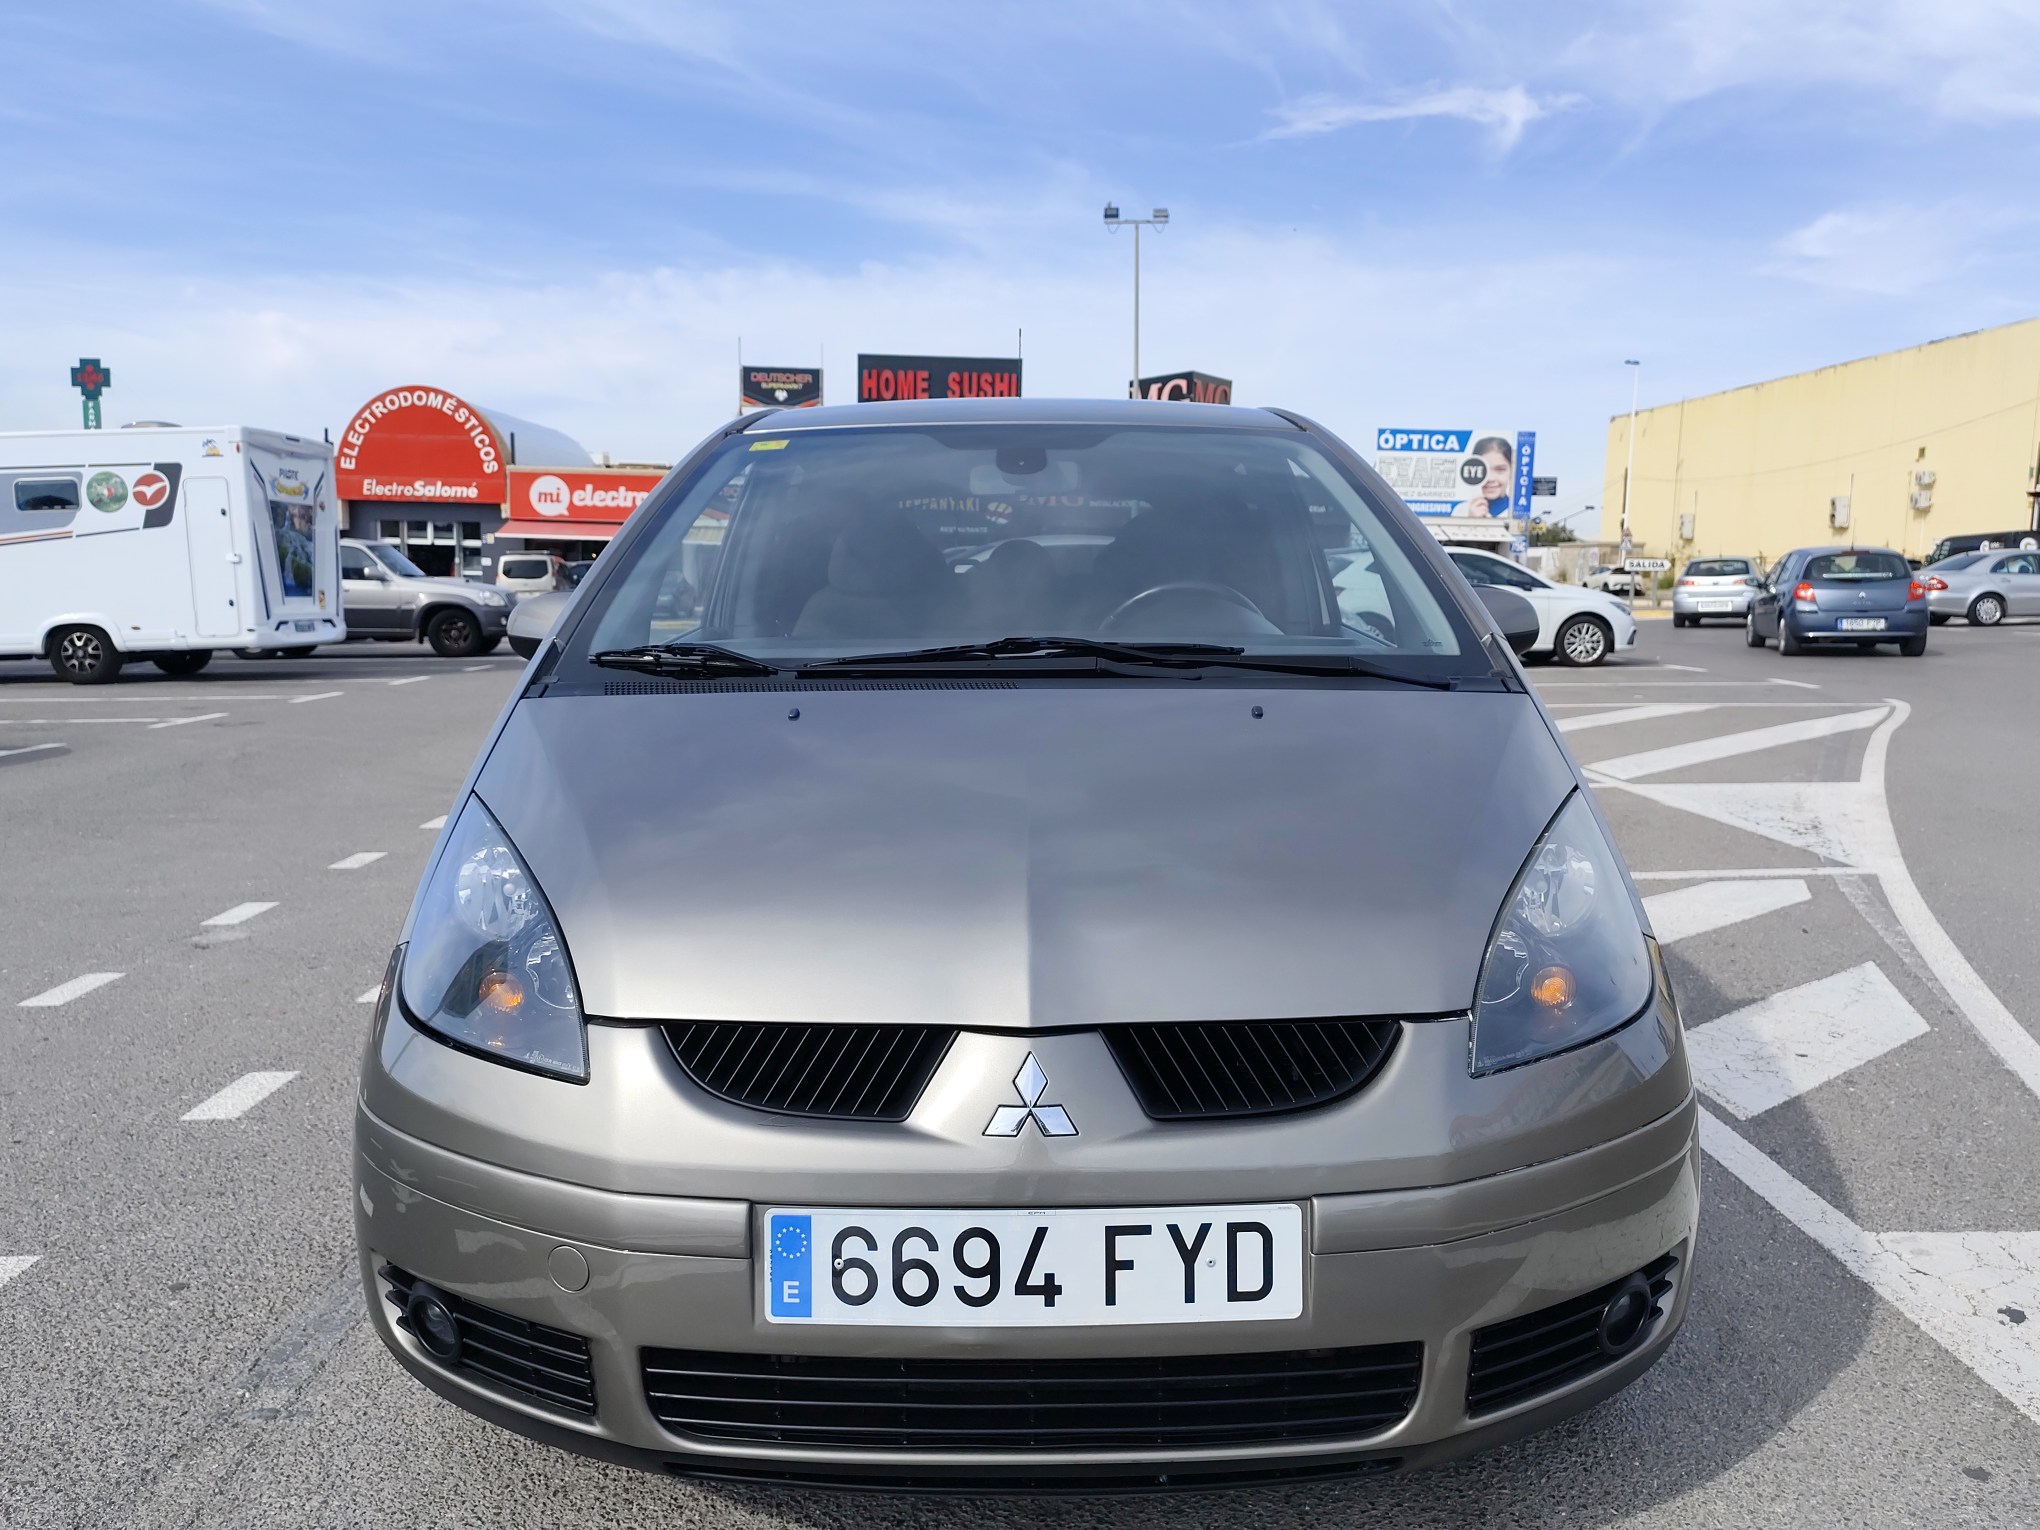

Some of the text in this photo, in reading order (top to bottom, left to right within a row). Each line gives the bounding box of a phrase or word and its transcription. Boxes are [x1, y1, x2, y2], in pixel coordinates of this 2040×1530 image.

[862, 368, 1018, 400] HOME SUSHI
[340, 390, 499, 474] ELECTRODOMÉSTICOS
[1379, 429, 1460, 451] ÓPTICA
[1462, 465, 1484, 478] EYE
[362, 478, 479, 498] ElectroSalomé
[537, 487, 563, 503] mi
[1627, 560, 1666, 569] SALIDA
[831, 1221, 1274, 1308] 6694 FYD
[782, 1280, 801, 1304] E
